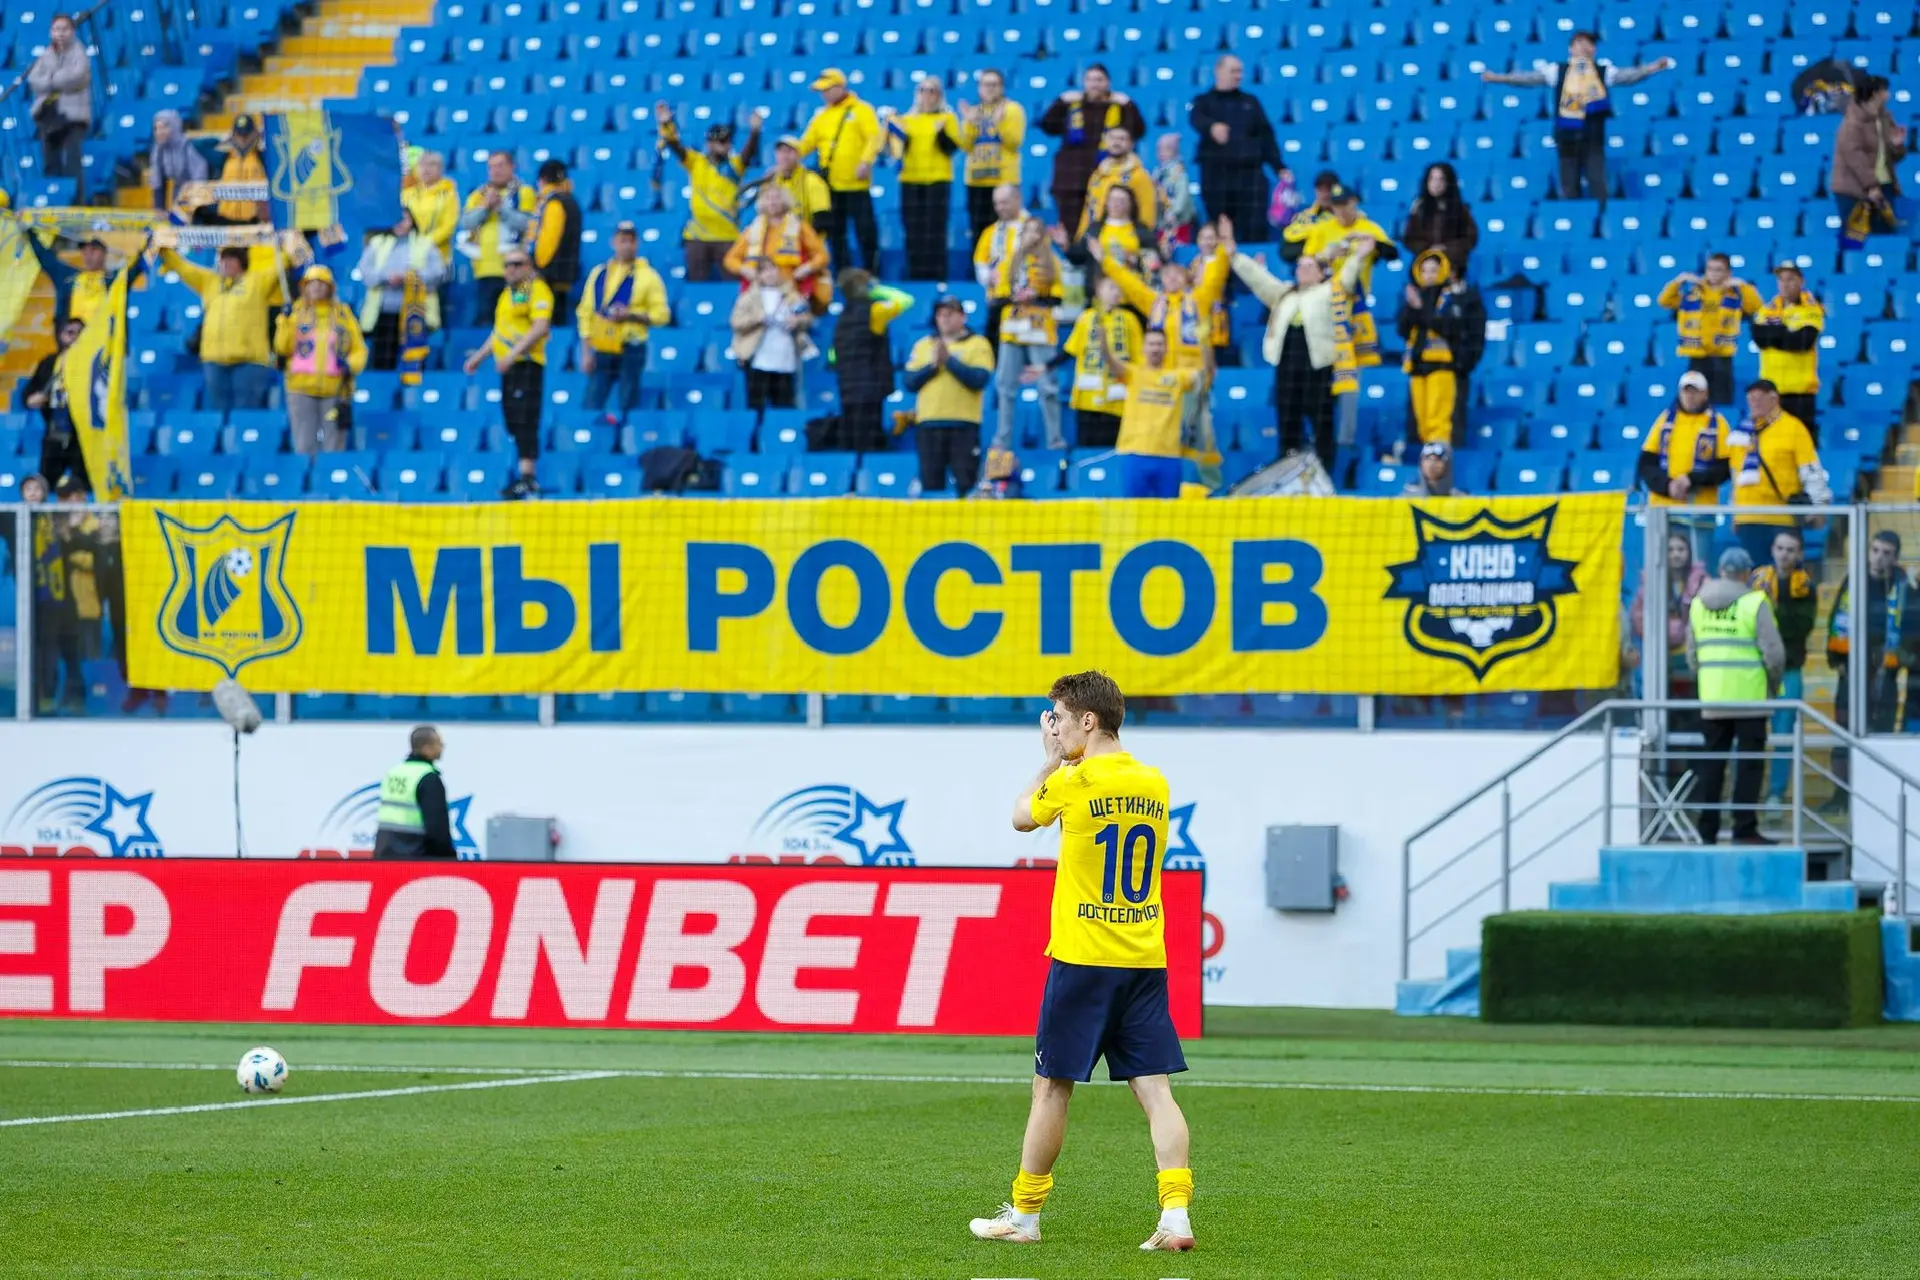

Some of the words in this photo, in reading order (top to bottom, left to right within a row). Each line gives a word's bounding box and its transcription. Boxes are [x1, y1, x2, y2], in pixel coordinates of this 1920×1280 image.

[364, 543, 622, 656] МЫ
[686, 539, 1328, 658] РОСТОВ
[1450, 544, 1515, 580] КЛУБ
[1089, 797, 1165, 820] ЩЕТИНИН
[1095, 824, 1156, 903] 10
[261, 875, 1002, 1028] FONBET
